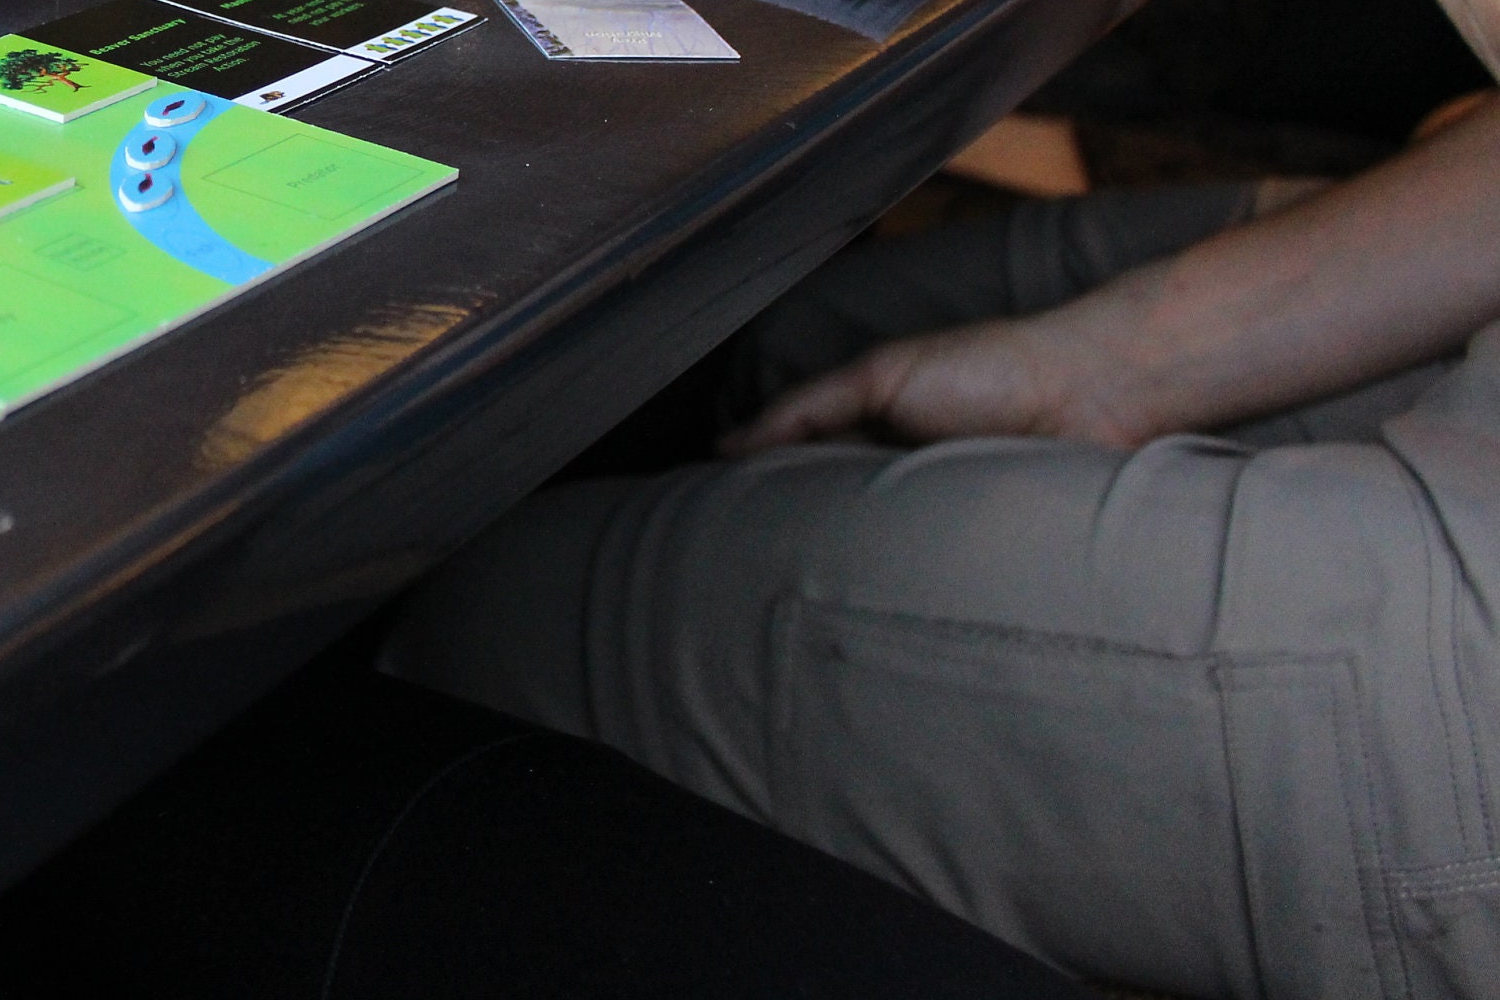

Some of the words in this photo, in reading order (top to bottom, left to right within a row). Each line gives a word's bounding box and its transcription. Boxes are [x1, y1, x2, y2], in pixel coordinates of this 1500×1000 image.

[89, 38, 131, 56] Beaver
[128, 18, 187, 42] Sanctuary
[155, 60, 185, 74] when
[183, 53, 205, 64] you
[201, 43, 227, 56] take
[223, 36, 245, 47] the
[162, 48, 191, 61] need
[188, 40, 208, 51] not
[205, 33, 227, 45] pay
[167, 62, 210, 79] Stream
[204, 40, 261, 65] Restoration
[212, 57, 250, 73] Action.
